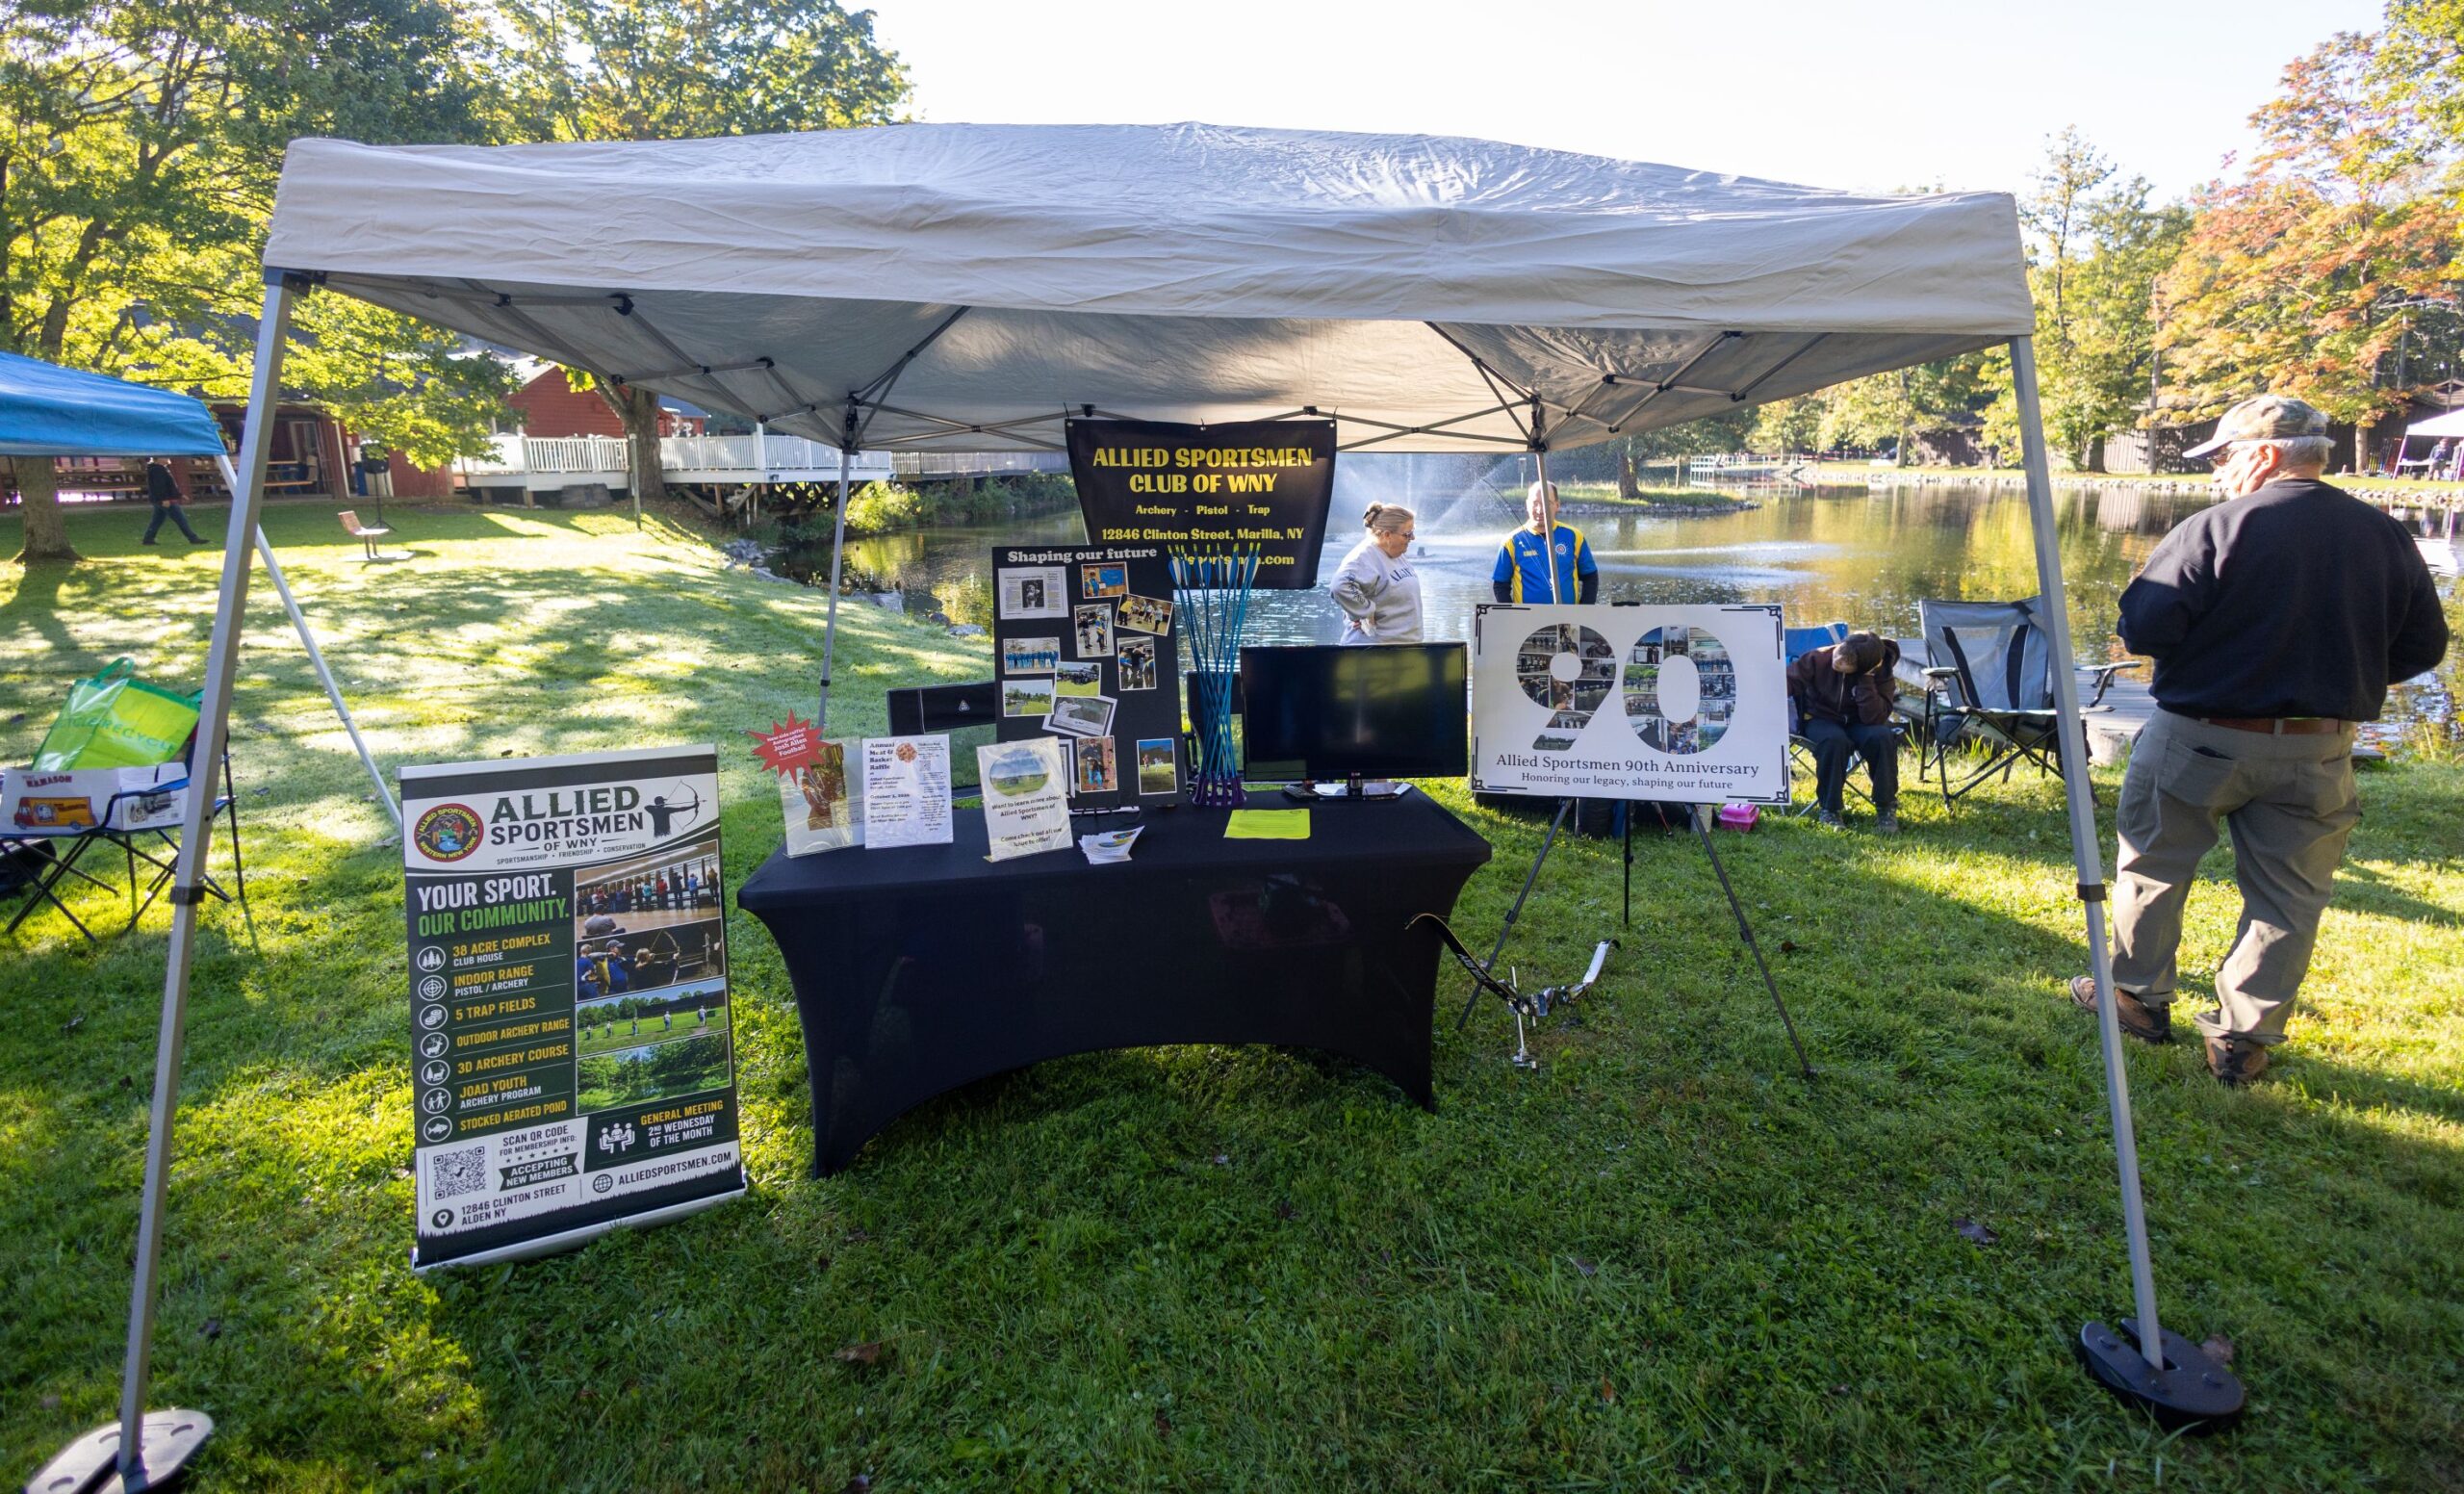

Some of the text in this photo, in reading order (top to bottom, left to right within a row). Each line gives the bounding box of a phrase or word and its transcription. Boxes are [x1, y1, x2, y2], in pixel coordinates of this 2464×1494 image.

[1093, 448, 1312, 467] ALLIED SPORTSMEN
[1129, 473, 1277, 493] CLUB OF WNY
[1135, 504, 1177, 517] Archery
[1196, 505, 1228, 515] Pistol
[1247, 504, 1270, 516] Trap
[1102, 528, 1304, 541] 12846 Clinton Street, Marilla, NY
[1008, 548, 1157, 564] Shaping our future
[1517, 624, 1736, 755] 90
[774, 738, 808, 751] Josh Allen
[778, 744, 807, 757] Football
[1496, 754, 1759, 778] Allied Sportsmen 90th Anniversary
[1521, 773, 1733, 790] Honoring our legacy, shaping our future
[490, 786, 640, 824] ALLIED
[992, 802, 1007, 810] Want
[1018, 805, 1049, 814] Sportsmen
[419, 808, 477, 832] ALLIED SPORTSMEN
[491, 811, 643, 846] SPORTSMEN
[544, 837, 598, 852] OF WNY
[1017, 831, 1034, 840] check
[448, 850, 463, 858] NEW
[463, 837, 477, 851] YORK
[497, 843, 646, 865] SPORTSMANSHIP FRIENDSHIP CONSERVATION
[417, 874, 557, 912] YOUR SPORT.
[418, 898, 570, 937] OUR COMMUNITY.
[452, 933, 552, 957] 38 ACRE COMPLEX
[453, 952, 503, 967] CLUB HOUSE
[453, 965, 534, 987] INDOOR RANGE
[455, 986, 484, 997] PISTOL
[492, 978, 529, 991] ARCHERY
[456, 997, 536, 1021] 5 TRAP FIELDS
[457, 1018, 570, 1047] OUTDOOR ARCHERY RANGE
[458, 1044, 569, 1075] 3D ARCHERY COURSE
[460, 1075, 527, 1098] JOAD YOUTH
[461, 1086, 541, 1109] ARCHERY PROGRAM
[461, 1100, 567, 1131] STOCKED AERATED POND
[640, 1100, 724, 1125] GENERAL MEETING
[503, 1133, 527, 1146] SCAN
[545, 1125, 568, 1138] CODE
[648, 1114, 715, 1136] 2ND WEDNESDAY
[499, 1135, 577, 1157] FOR MEMBERSHIP INFO:
[650, 1126, 713, 1147] OF THE MONTH
[506, 1165, 573, 1187] NEW MEMBERS
[511, 1157, 567, 1176] ACCEPTING
[618, 1151, 731, 1185] ALLIEDSPORTSMEN.COM
[462, 1184, 566, 1215] 12846 CLINTON STREET
[462, 1208, 507, 1226] ALDEN NY
